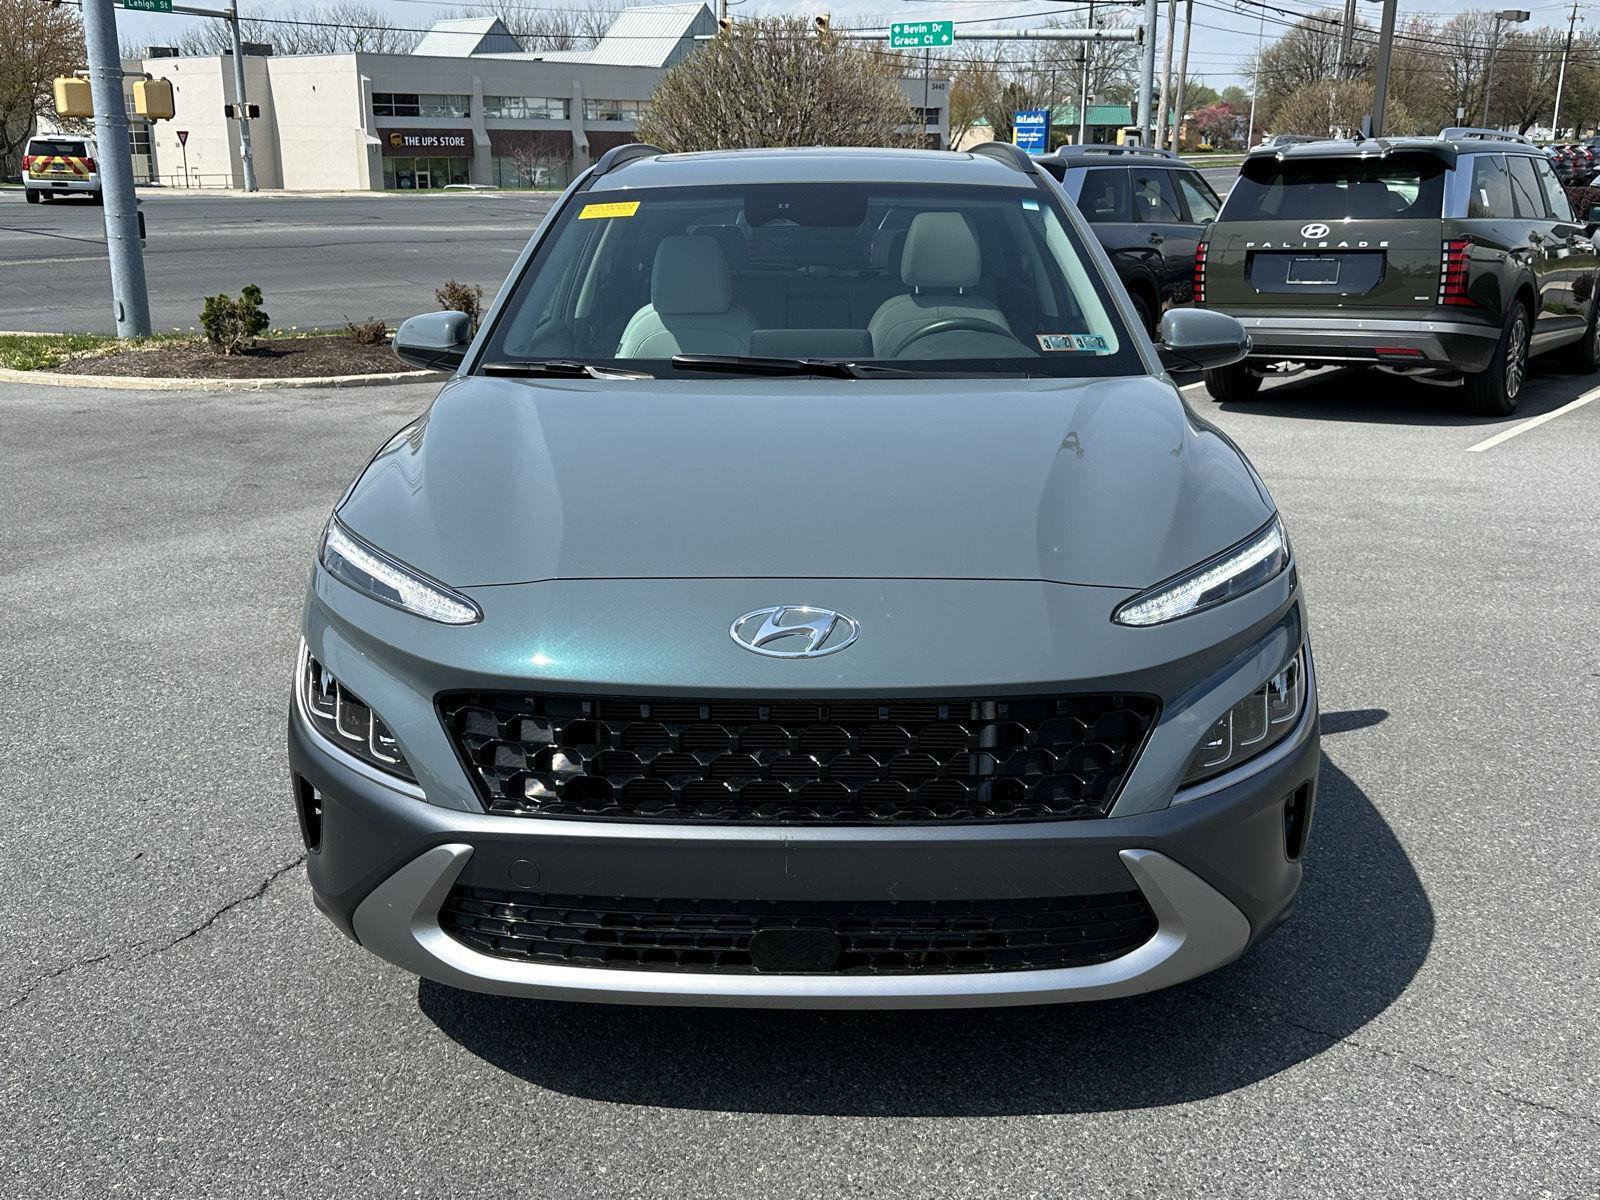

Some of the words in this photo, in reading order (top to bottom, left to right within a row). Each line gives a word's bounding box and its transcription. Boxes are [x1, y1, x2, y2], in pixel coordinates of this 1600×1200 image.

[128, 0, 155, 9] Lehigh
[160, 1, 168, 9] St
[903, 24, 927, 34] Bevin
[932, 23, 943, 33] Dr
[894, 36, 919, 45] Grace
[924, 34, 934, 44] Ct
[404, 136, 420, 146] THE
[422, 136, 438, 147] UPS
[440, 136, 465, 147] STORE
